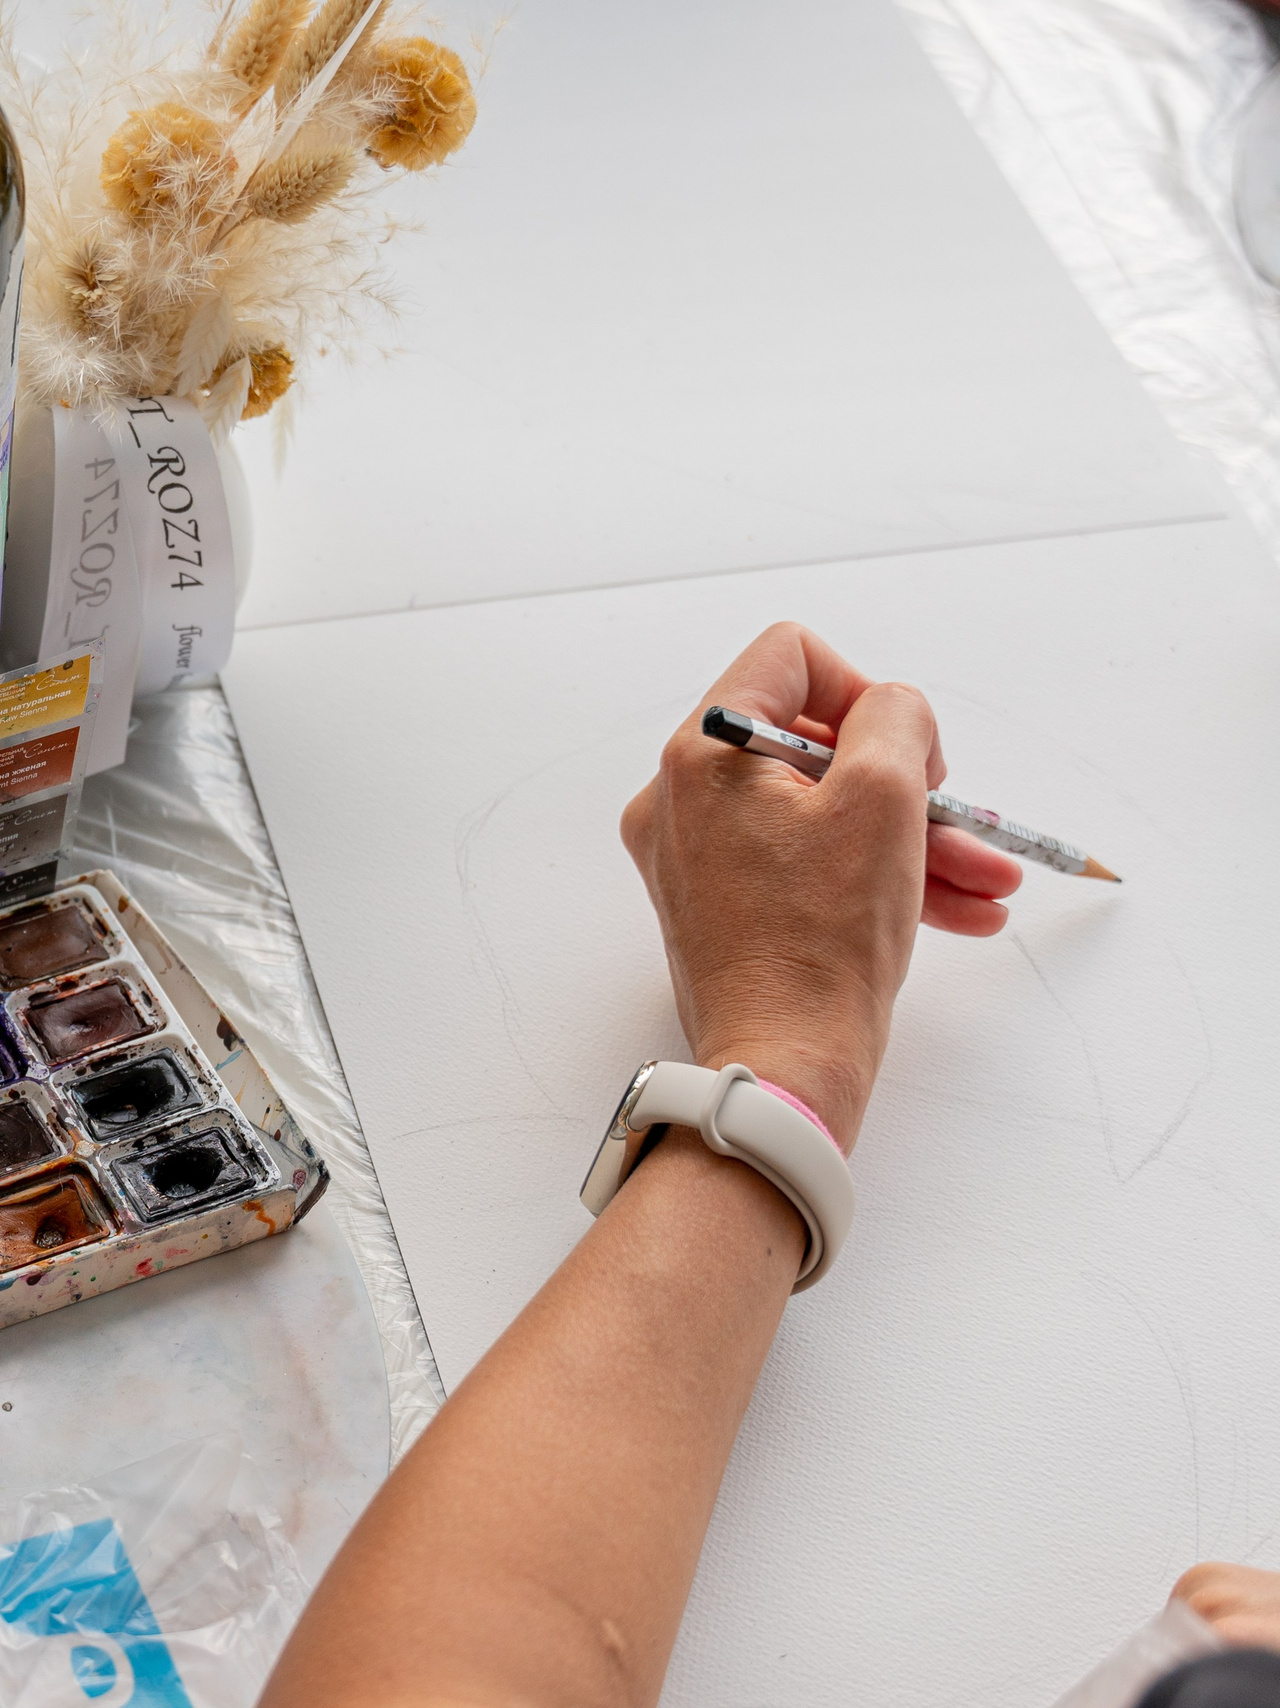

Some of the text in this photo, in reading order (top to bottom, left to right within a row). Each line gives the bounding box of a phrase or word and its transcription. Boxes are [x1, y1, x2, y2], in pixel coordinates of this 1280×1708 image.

[10, 689, 72, 713] натуральная
[19, 704, 48, 718] Sienna
[11, 760, 47, 777] жженая
[10, 772, 38, 786] Sienna
